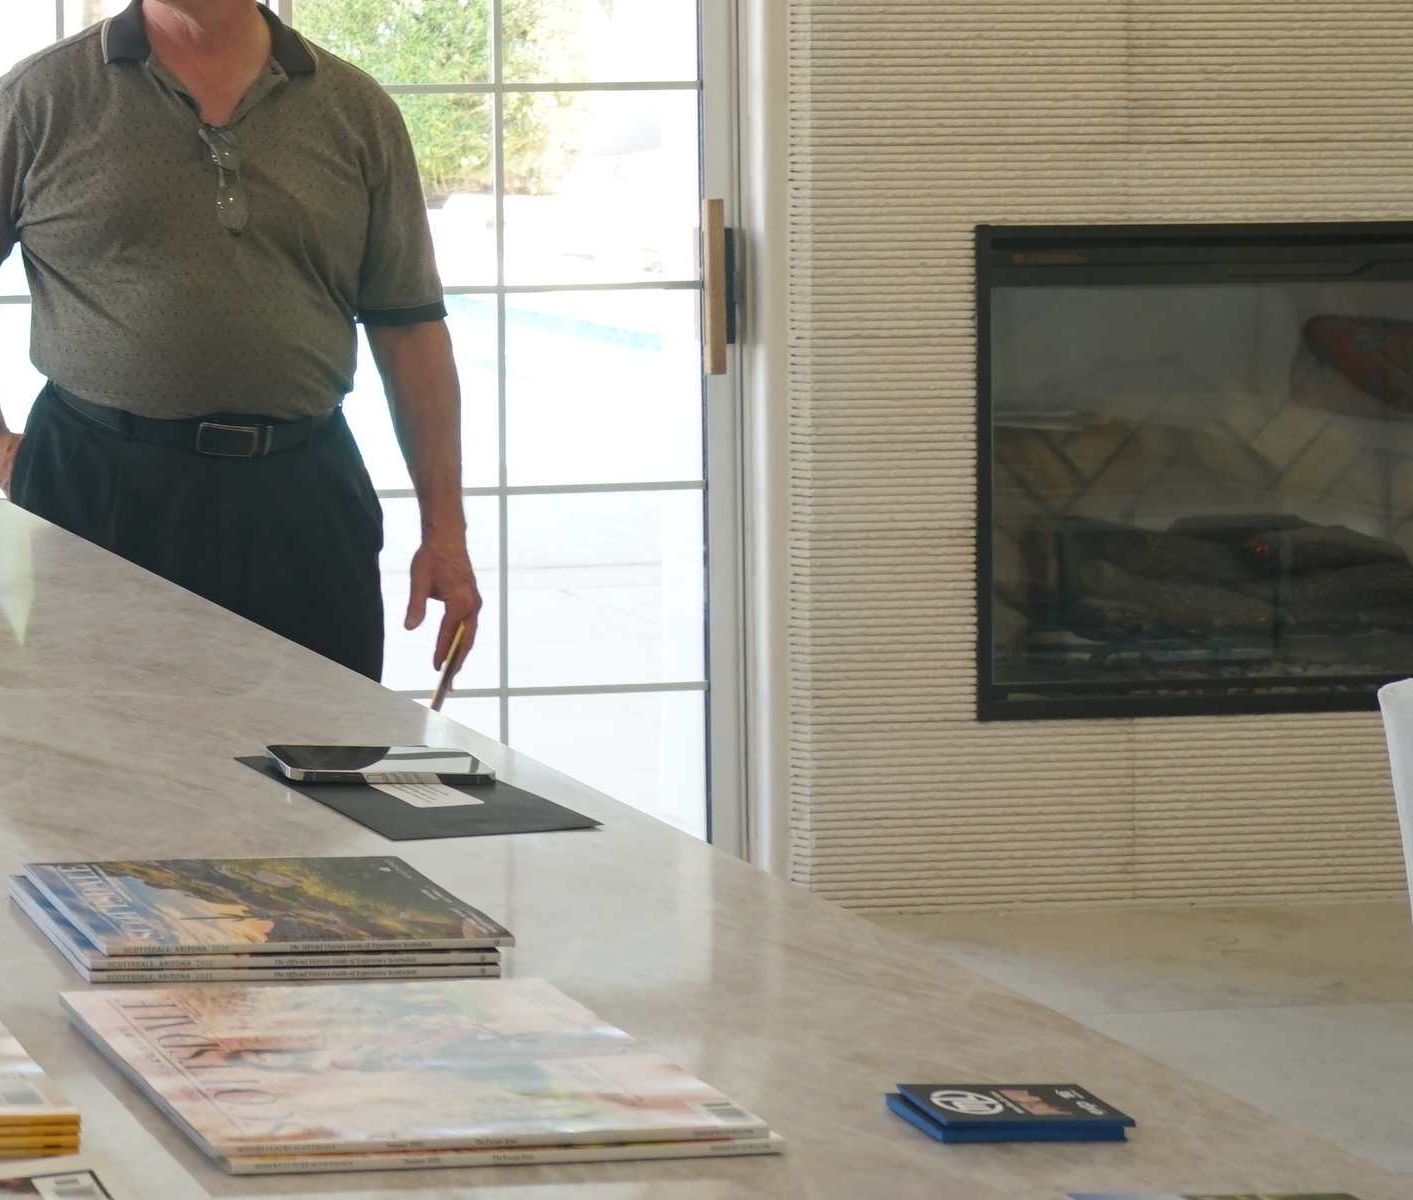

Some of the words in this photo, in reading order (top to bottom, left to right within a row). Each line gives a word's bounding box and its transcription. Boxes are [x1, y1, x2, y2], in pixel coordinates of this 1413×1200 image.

[57, 865, 160, 939] SCOTTSDALE
[174, 945, 208, 953] ARIZONA
[115, 998, 297, 1134] SCOTTSDALE
